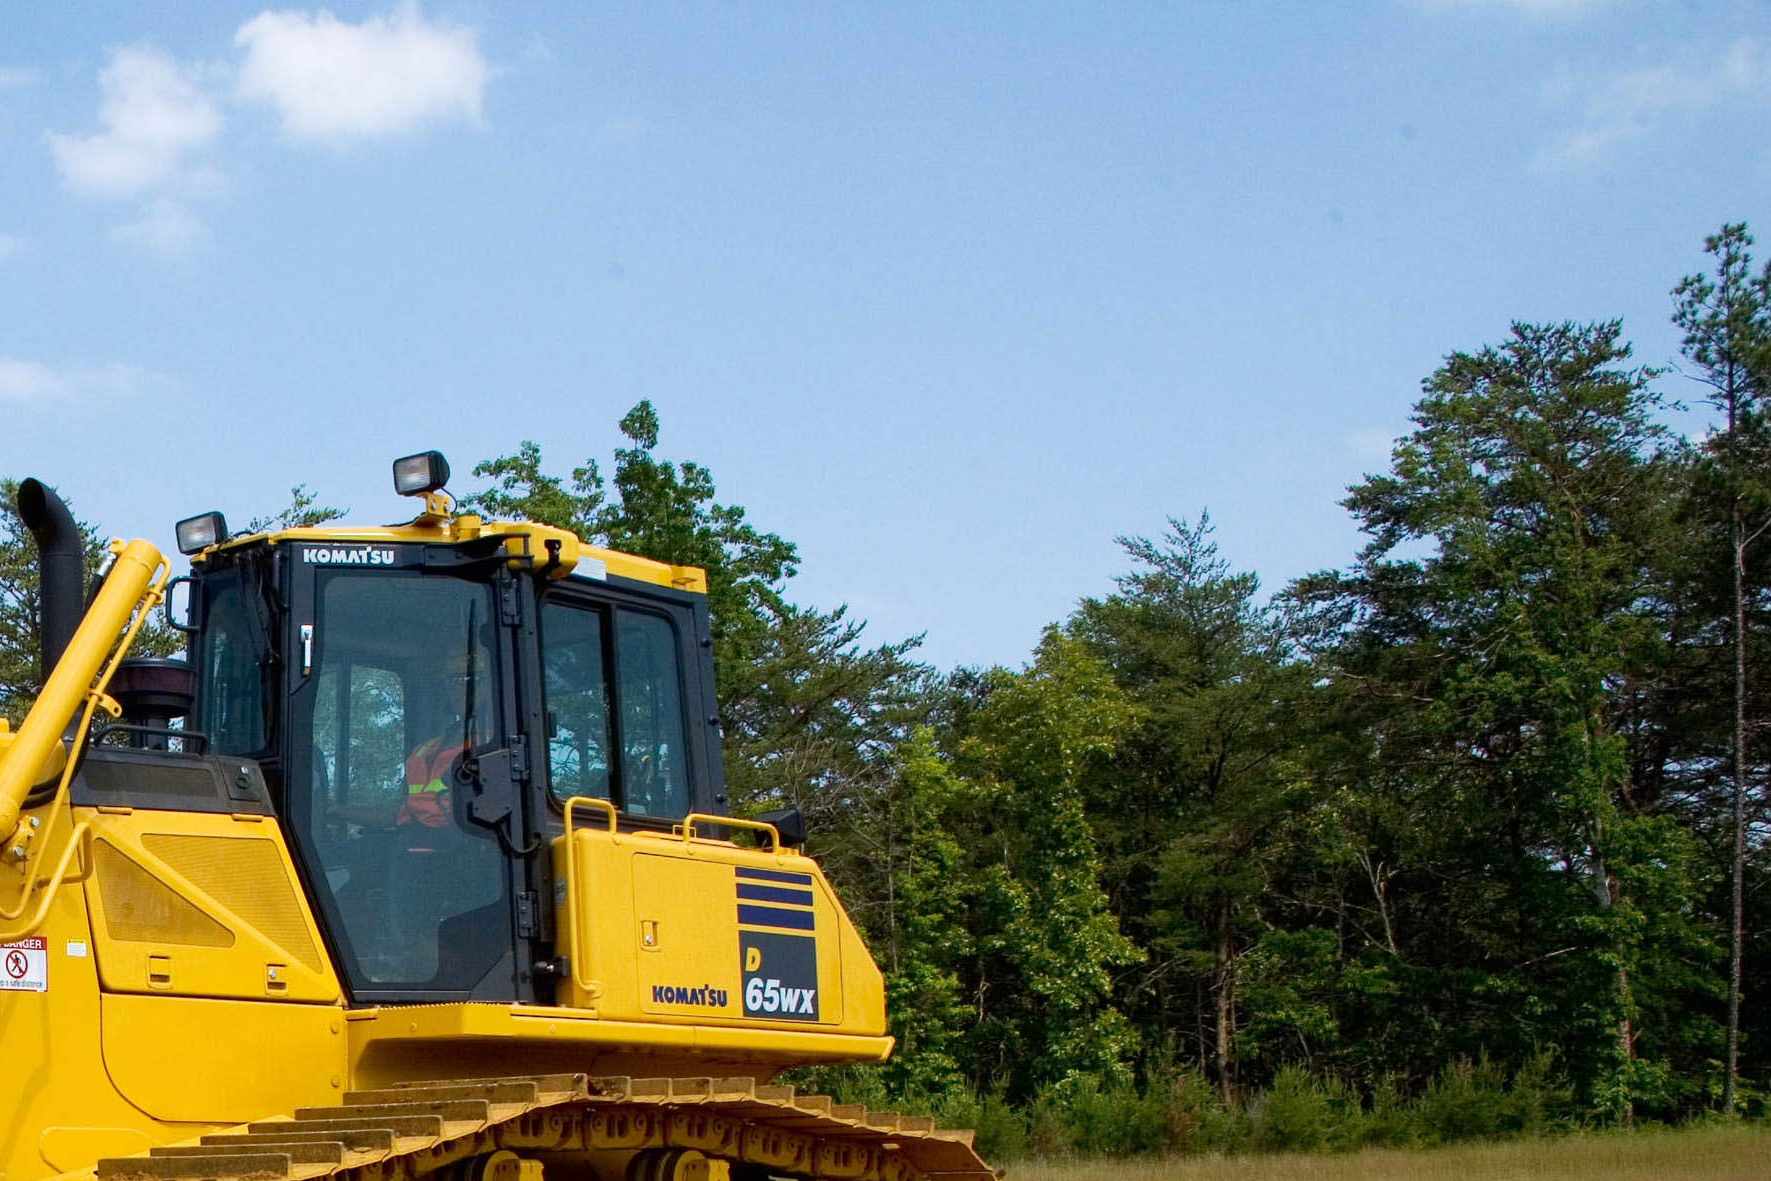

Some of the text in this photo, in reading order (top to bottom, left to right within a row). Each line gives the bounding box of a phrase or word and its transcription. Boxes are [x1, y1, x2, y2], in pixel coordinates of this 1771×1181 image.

[303, 546, 394, 565] KOMATSU
[745, 947, 761, 972] D
[652, 984, 727, 1007] KOMATSU
[745, 978, 816, 1014] 65WX
